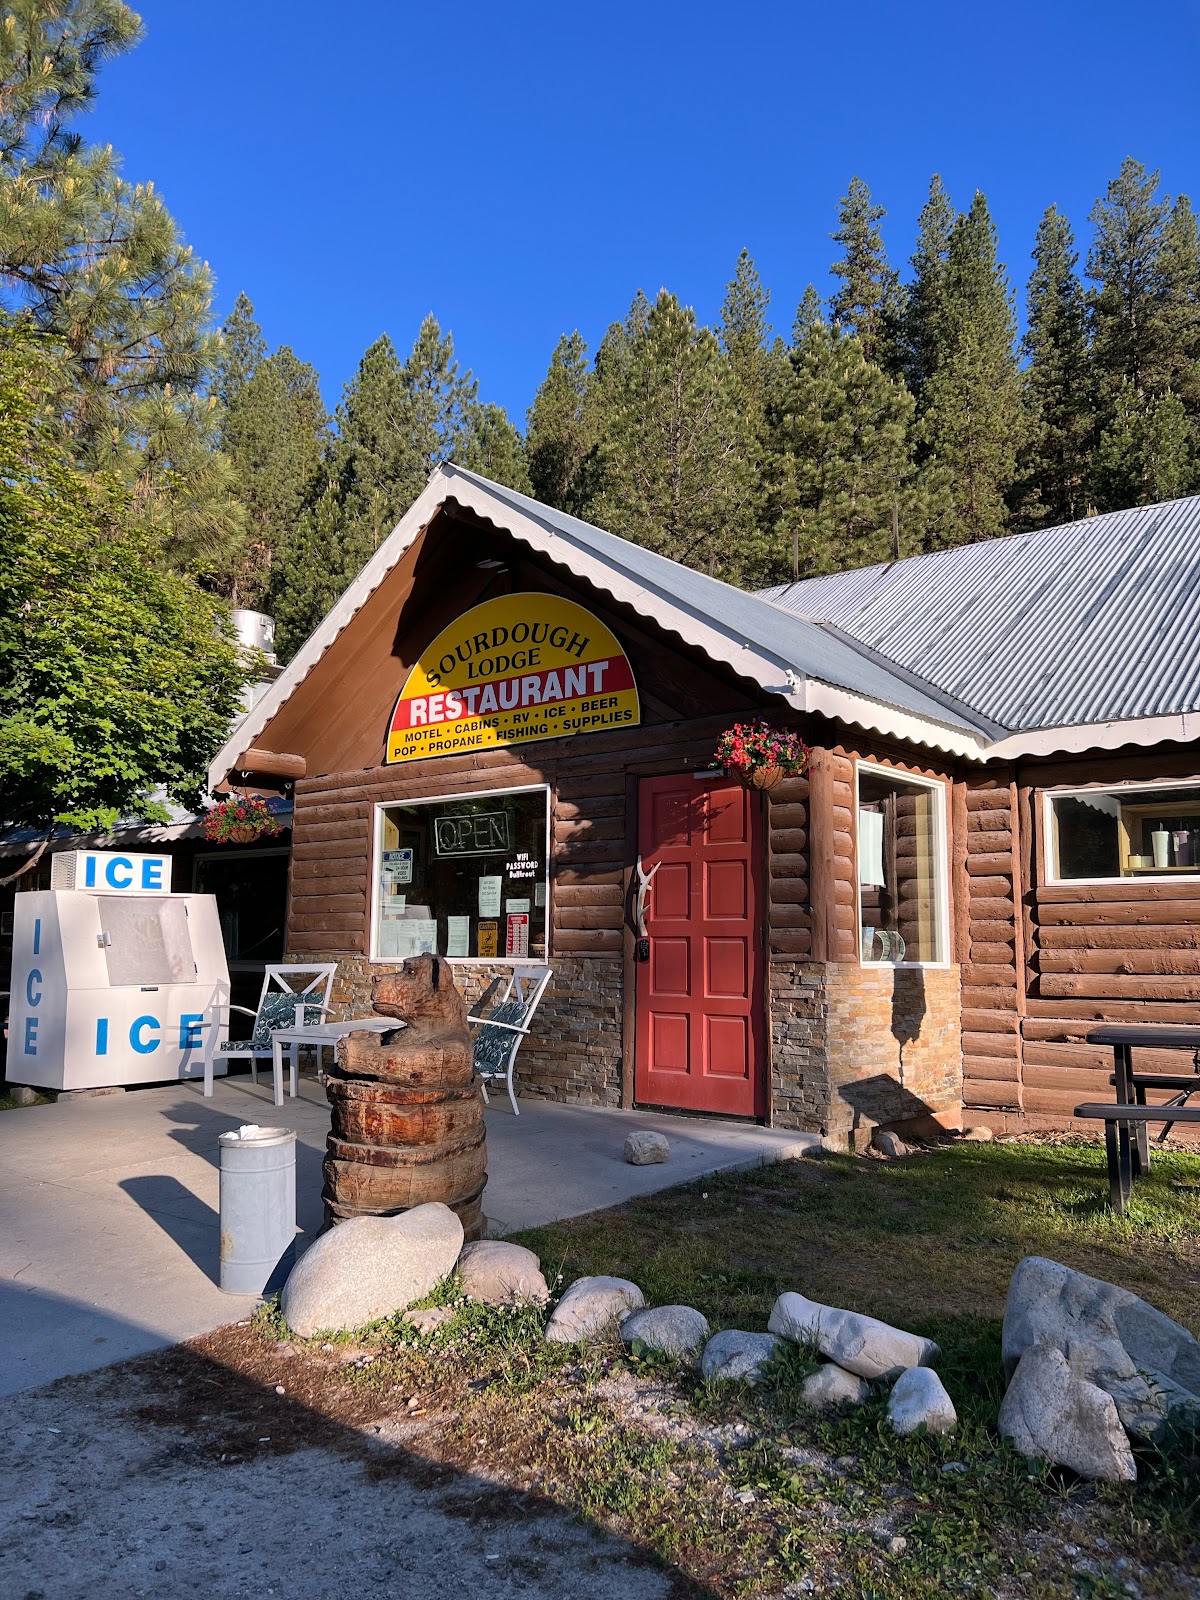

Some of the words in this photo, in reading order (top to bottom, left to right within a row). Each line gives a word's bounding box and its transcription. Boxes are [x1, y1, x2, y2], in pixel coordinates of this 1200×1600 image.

[426, 622, 590, 688] SOURDOUGH
[467, 648, 541, 680] LODGE
[410, 661, 609, 727] RESTAURANT
[394, 745, 417, 758] POP
[429, 735, 482, 752] PROPANE
[496, 723, 548, 740] FISHING
[563, 709, 633, 730] SUPPLIES
[405, 728, 442, 743] MOTEL
[455, 718, 499, 734] CABINS
[513, 712, 530, 724] RV
[544, 706, 566, 719] ICE
[581, 697, 618, 713] BEER
[439, 818, 506, 850] OPEN
[85, 856, 163, 889] ICE
[506, 861, 539, 870] PASSWORD
[516, 853, 529, 861] WIFI
[24, 918, 43, 1056] ICE
[95, 1013, 204, 1056] ICE
